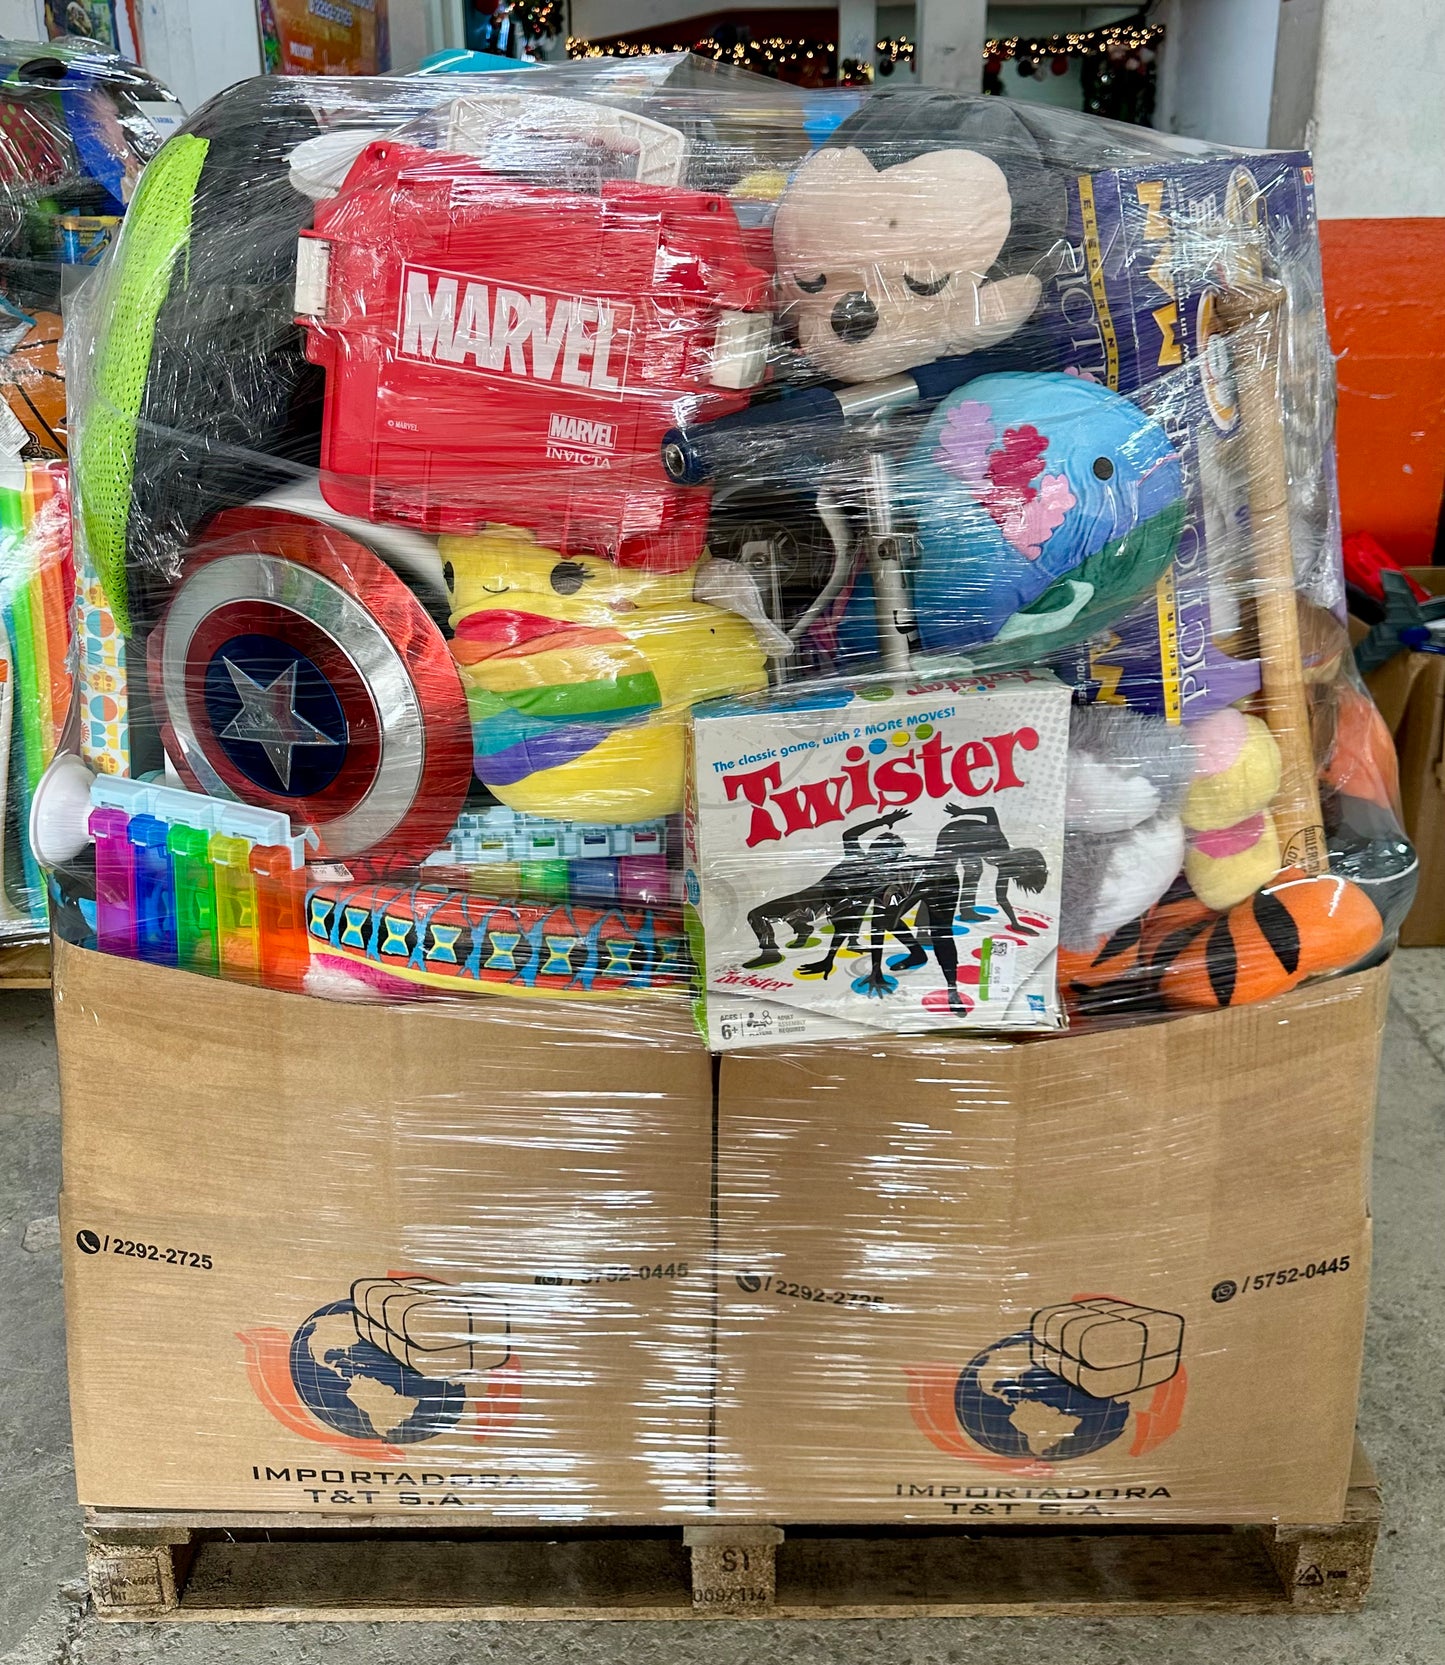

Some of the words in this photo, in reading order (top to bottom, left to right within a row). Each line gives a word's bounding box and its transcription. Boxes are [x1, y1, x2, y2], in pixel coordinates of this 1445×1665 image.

[1083, 199, 1117, 387] ELECTRONIC
[401, 270, 621, 389] MARVEL
[1055, 243, 1107, 386] PICTI
[395, 420, 419, 432] MARVEL
[551, 415, 614, 448] MARVEL
[545, 447, 612, 469] INVICTA
[1162, 571, 1181, 711] ELECTRON
[712, 761, 735, 774] The
[738, 748, 777, 766] classic
[780, 739, 820, 758] game,
[823, 730, 850, 746] with
[853, 727, 862, 738] 2
[865, 719, 903, 736] MORE
[906, 706, 956, 726] MOVES!
[723, 726, 1039, 848] Twister
[721, 1024, 738, 1040] 6+
[113, 1238, 213, 1270] 2292-2725
[1253, 1255, 1351, 1291] 5752-0445
[304, 1488, 381, 1504] T&T
[896, 1484, 1172, 1499] IMPORTADORA
[943, 1502, 1021, 1515] T&T
[1038, 1503, 1117, 1516] S.A.
